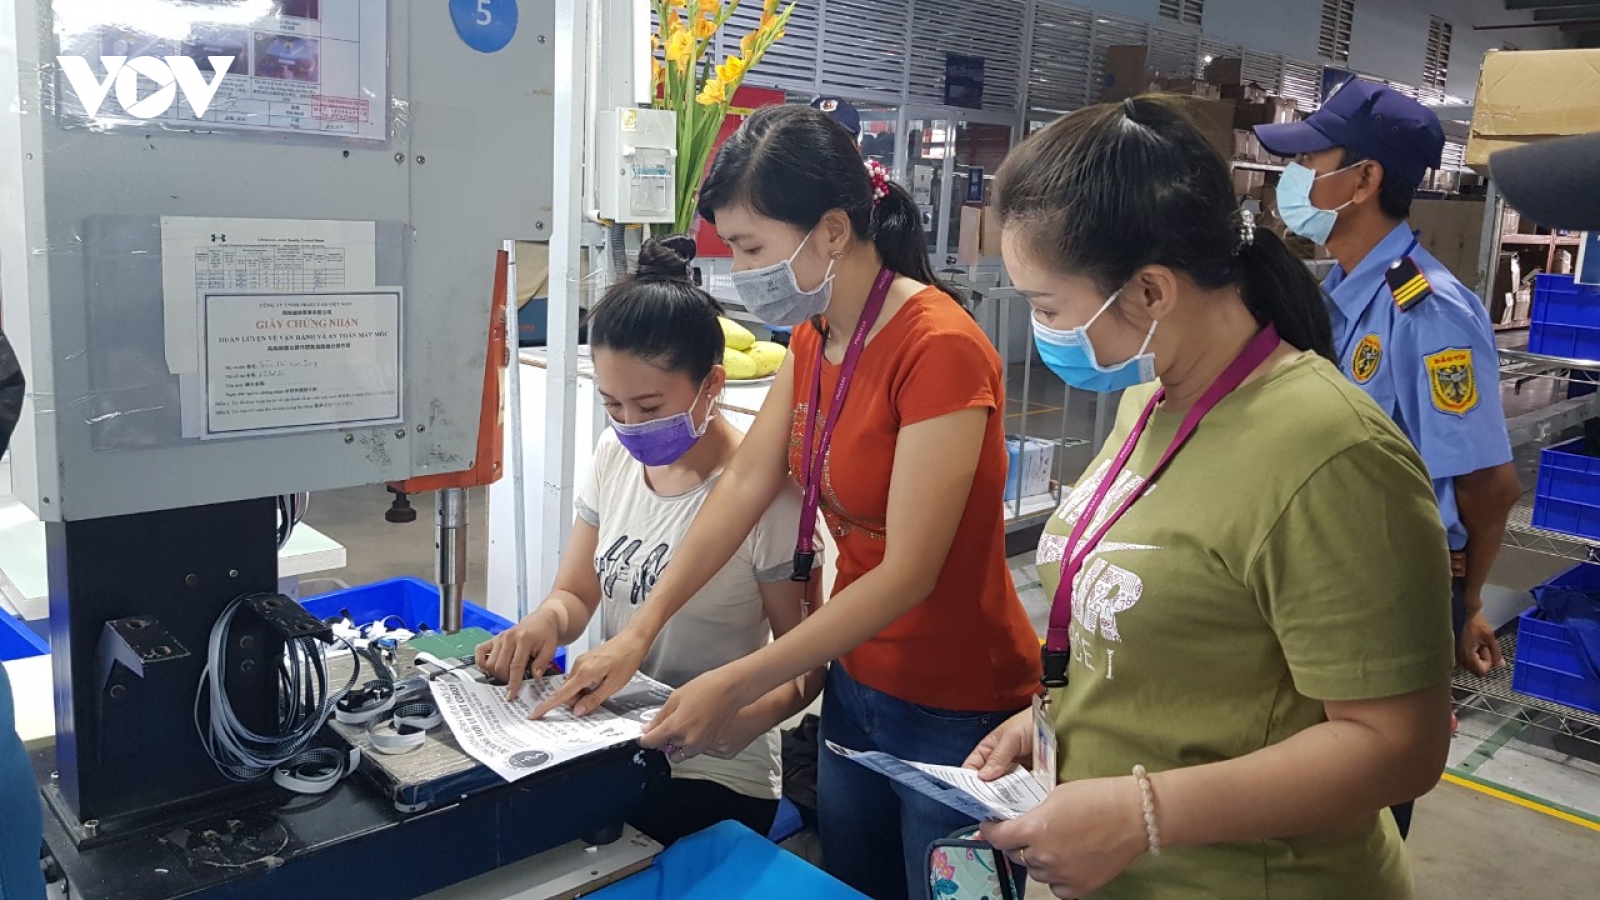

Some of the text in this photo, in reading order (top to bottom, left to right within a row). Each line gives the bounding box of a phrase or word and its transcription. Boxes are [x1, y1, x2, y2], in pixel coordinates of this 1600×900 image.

[476, 0, 491, 25] 5
[255, 317, 359, 330] GIẤY CHỨNG NHẬN
[448, 683, 466, 703] CORO
